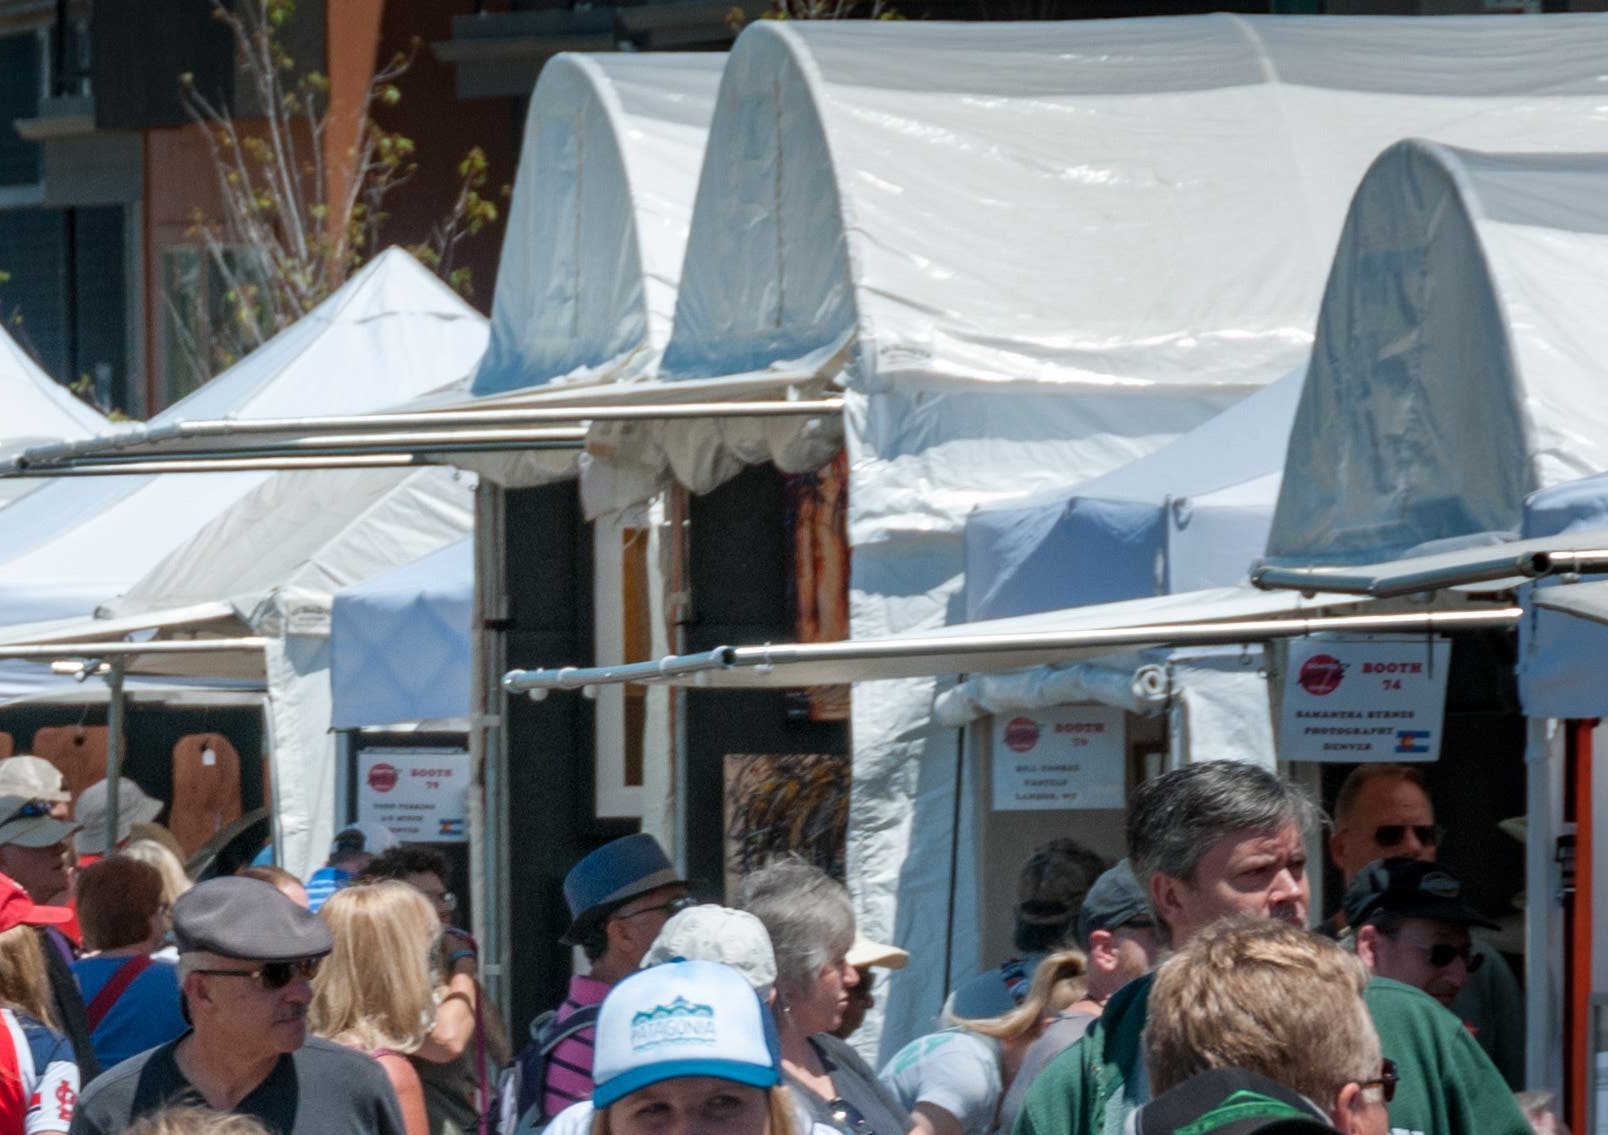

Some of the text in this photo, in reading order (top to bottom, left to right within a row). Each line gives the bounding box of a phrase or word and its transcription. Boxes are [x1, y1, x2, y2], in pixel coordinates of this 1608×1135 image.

[1362, 661, 1424, 674] BOOTH
[1382, 679, 1402, 691] 74
[1295, 709, 1363, 719] SAMANTHA
[1054, 722, 1105, 733] BOOTH
[1303, 726, 1395, 736] PHOTOGRAPHY
[1322, 742, 1373, 751] DENVER
[410, 768, 453, 778] BOOTH
[631, 1019, 717, 1042] PATAGONIA
